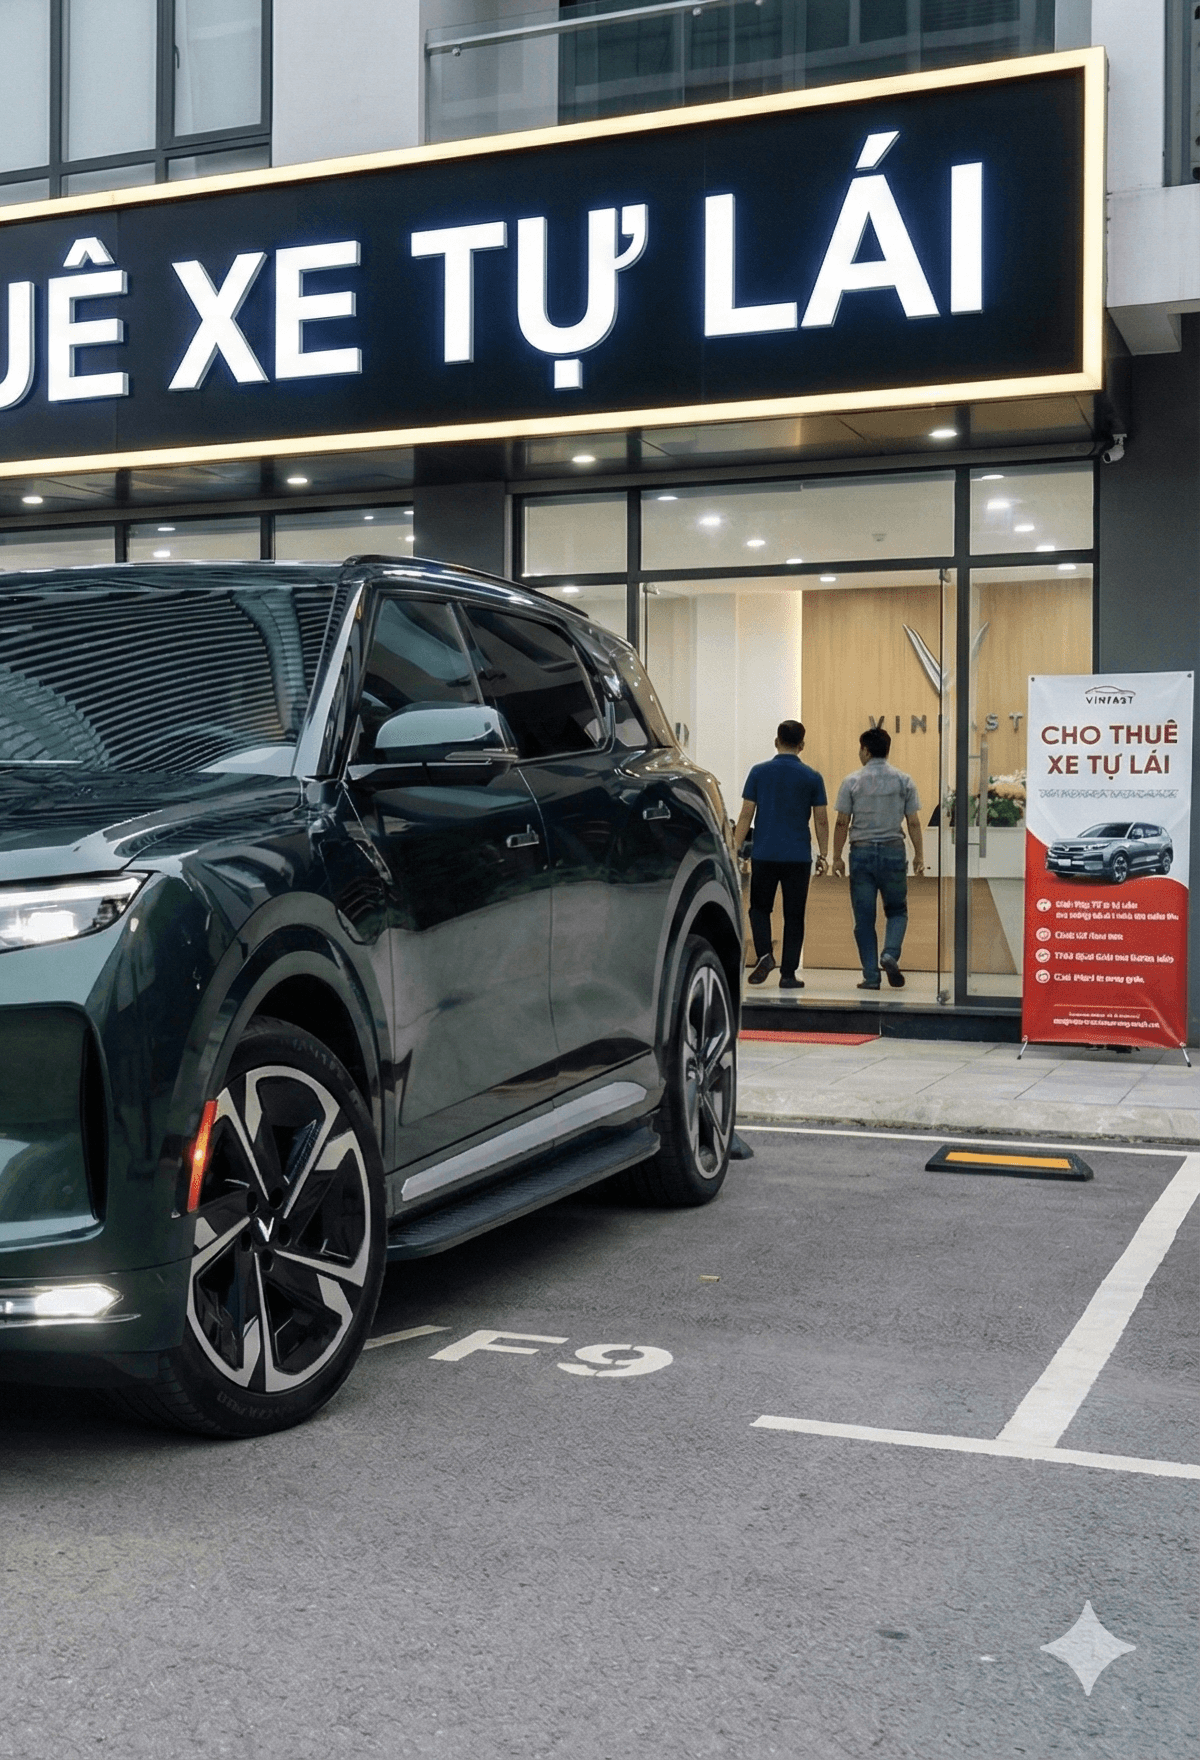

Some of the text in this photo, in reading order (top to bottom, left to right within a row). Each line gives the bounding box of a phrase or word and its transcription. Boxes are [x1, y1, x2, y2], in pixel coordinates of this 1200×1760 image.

[167, 239, 362, 392] XE
[410, 203, 648, 390] TỰ
[704, 130, 983, 337] LÁI
[1041, 719, 1178, 745] CHO THUÊ
[1047, 749, 1170, 780] XE TỰ LÁI
